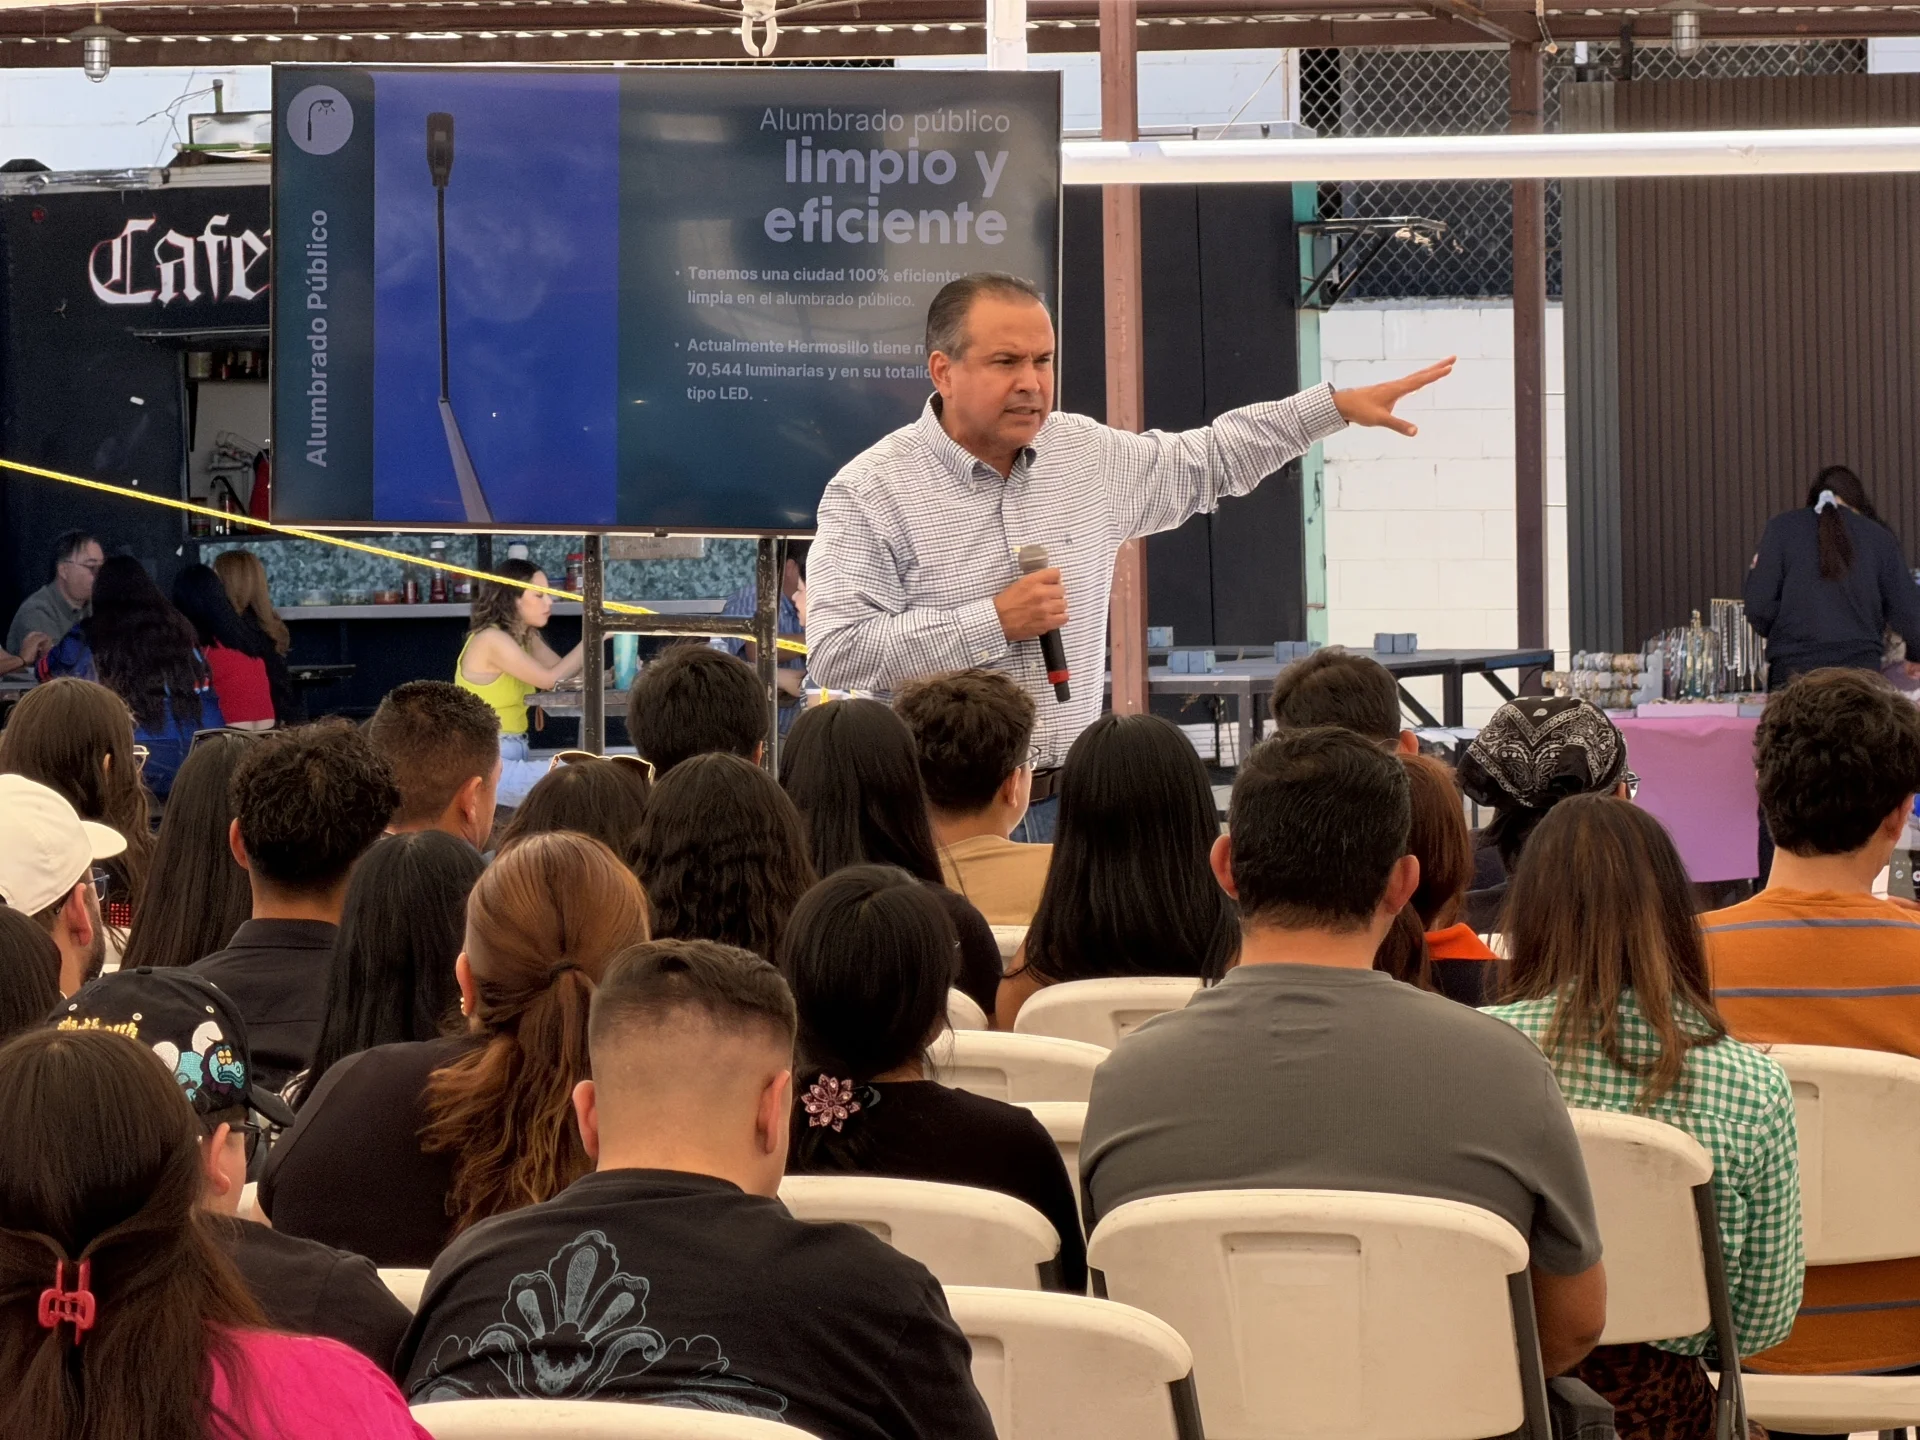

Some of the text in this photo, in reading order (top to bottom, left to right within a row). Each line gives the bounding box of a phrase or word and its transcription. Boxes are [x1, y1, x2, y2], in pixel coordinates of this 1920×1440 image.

[760, 107, 1010, 138] Alumbrado público
[785, 136, 1009, 198] limpio y
[764, 196, 1008, 245] eficiente
[88, 213, 271, 308] Cafe
[688, 266, 758, 281] Tenemos
[761, 270, 790, 281] una
[793, 267, 844, 282] ciudad
[848, 268, 889, 282] 100%
[893, 268, 960, 282] eficiente
[687, 290, 915, 309] limpia en el alumbrado público.
[306, 209, 328, 468] Alumbrado Público
[686, 339, 784, 353] Actualmente
[787, 340, 869, 354] Hermosillo
[873, 342, 911, 355] tiene
[686, 362, 742, 379] 70,544
[745, 364, 824, 378] luminarias
[828, 367, 841, 381] y
[841, 367, 859, 378] en
[863, 368, 881, 379] su
[686, 387, 753, 402] tipo LED.
